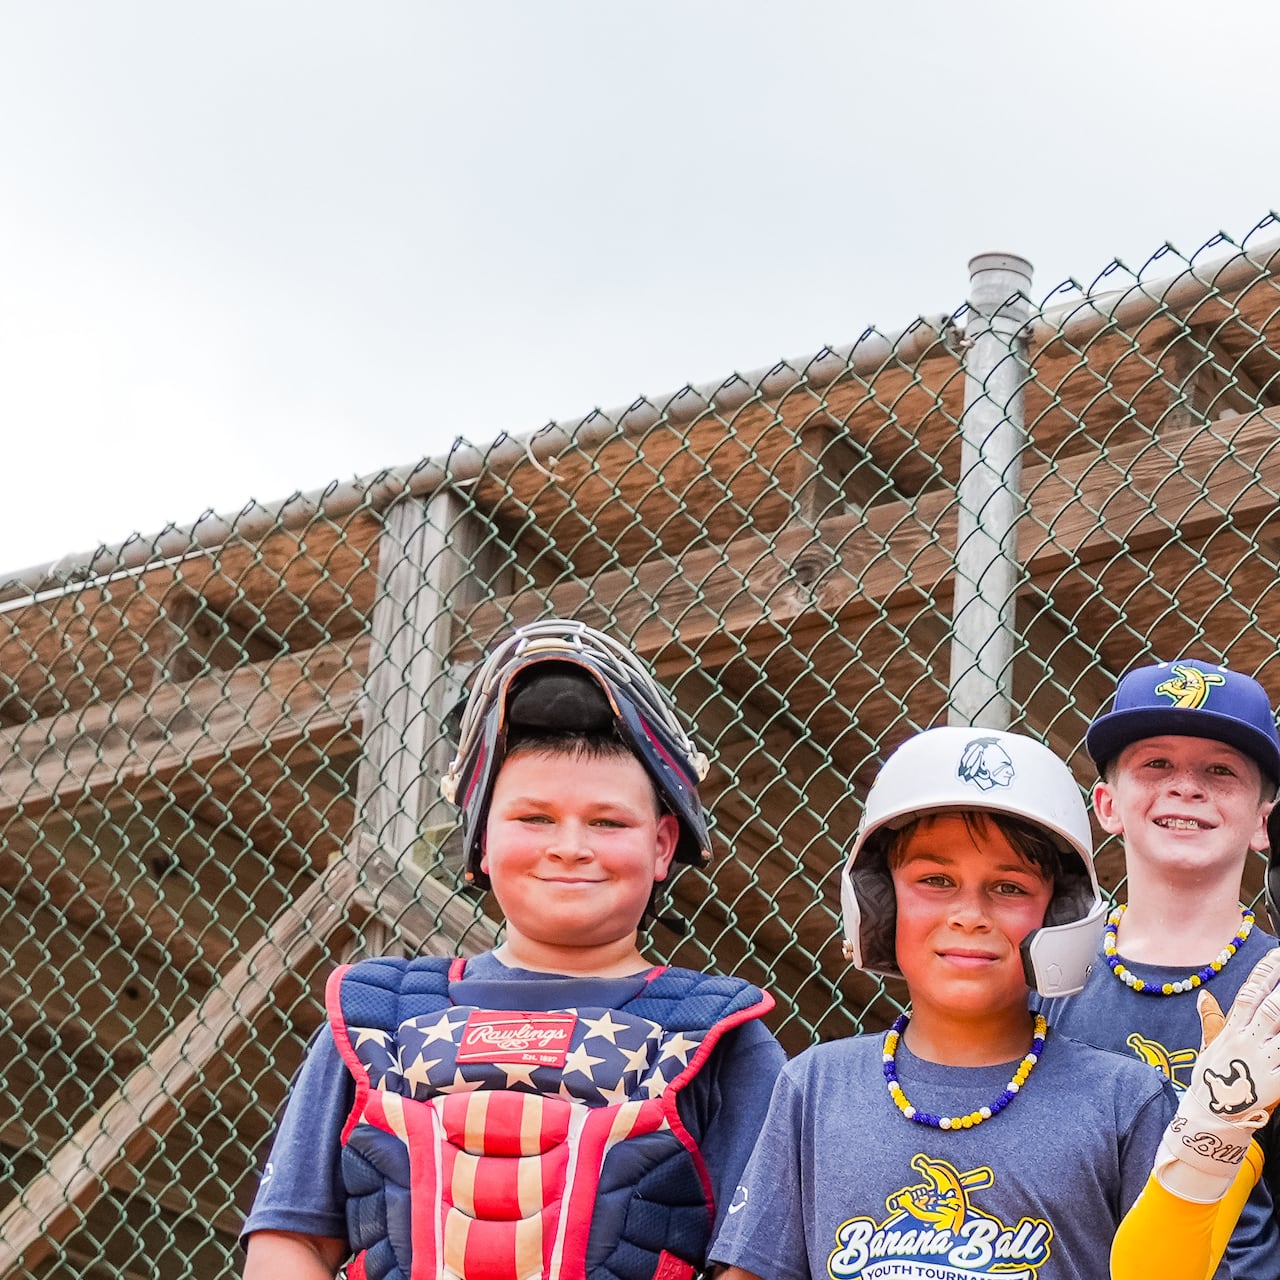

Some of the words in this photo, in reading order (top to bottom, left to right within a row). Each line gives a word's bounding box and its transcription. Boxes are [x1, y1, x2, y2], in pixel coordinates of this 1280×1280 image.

[466, 1023, 567, 1047] Rawlings
[830, 1220, 953, 1272] Banana
[948, 1218, 1046, 1270] Ball
[866, 1264, 913, 1280] YOUTH
